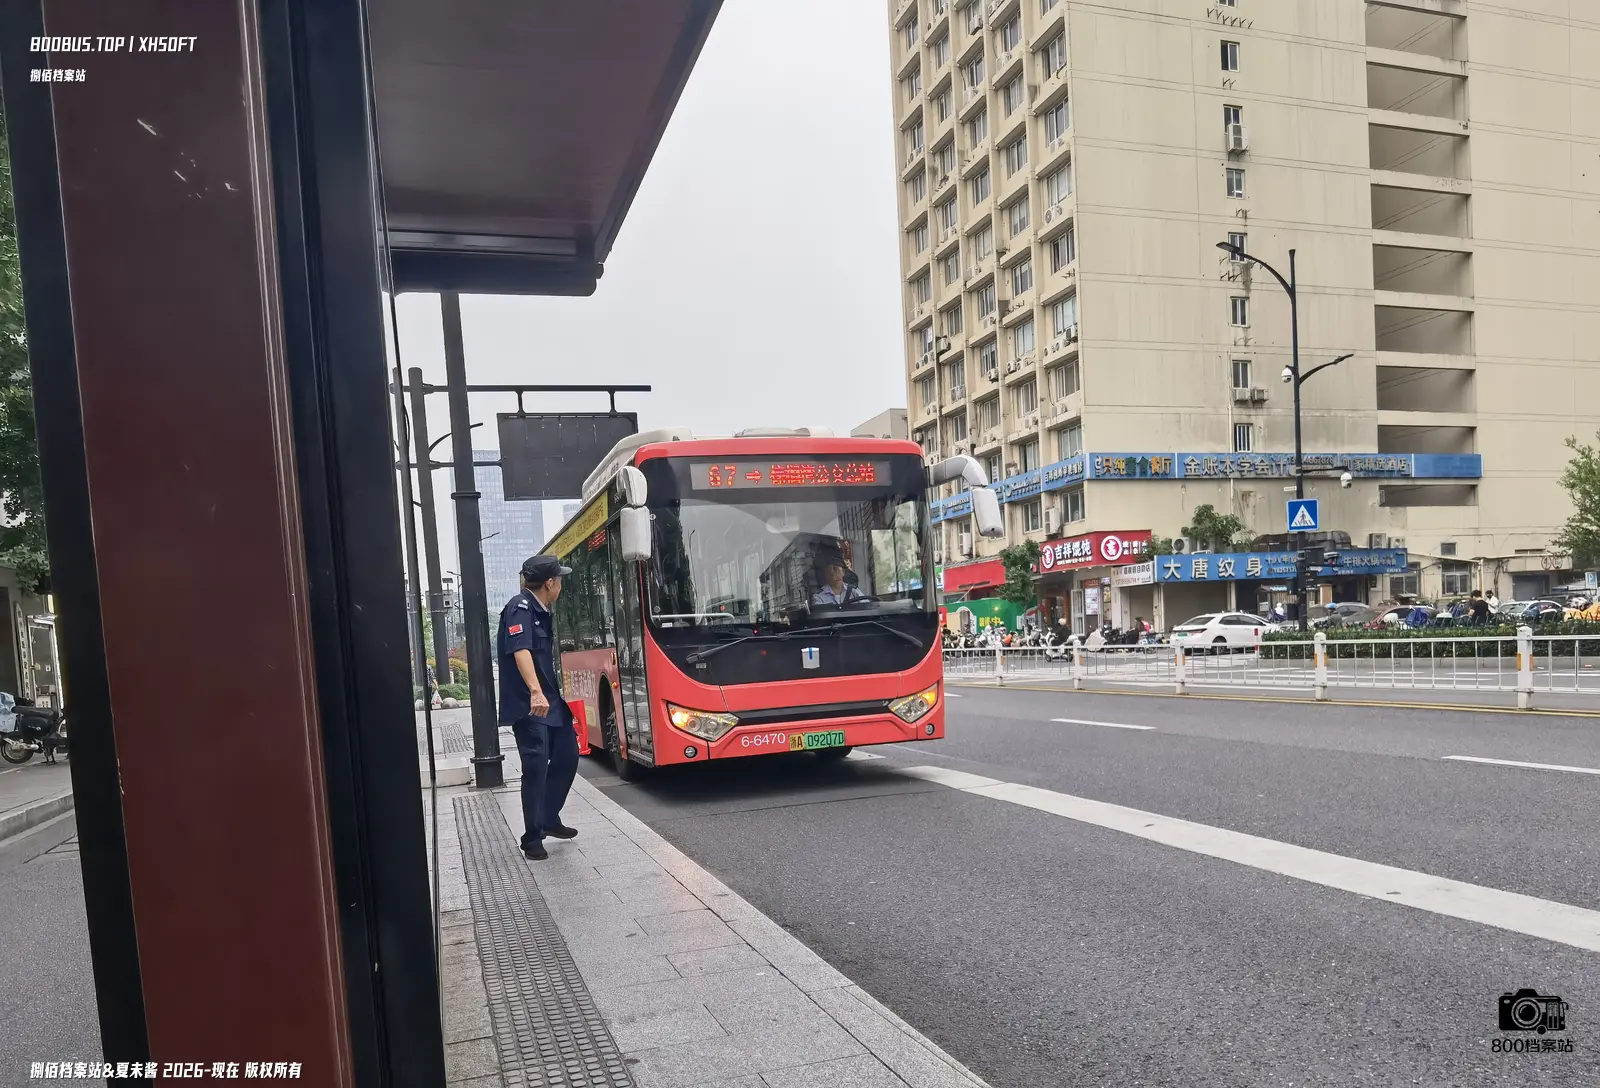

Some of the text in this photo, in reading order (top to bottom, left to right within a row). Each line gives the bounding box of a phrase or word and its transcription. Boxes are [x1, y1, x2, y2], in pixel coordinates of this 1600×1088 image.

[708, 464, 737, 487] 67
[1183, 455, 1287, 477] 金账本学会计
[1054, 539, 1092, 560] 吉祥馄饨
[1163, 558, 1263, 579] 大唐纹身
[741, 732, 786, 748] 6-6470
